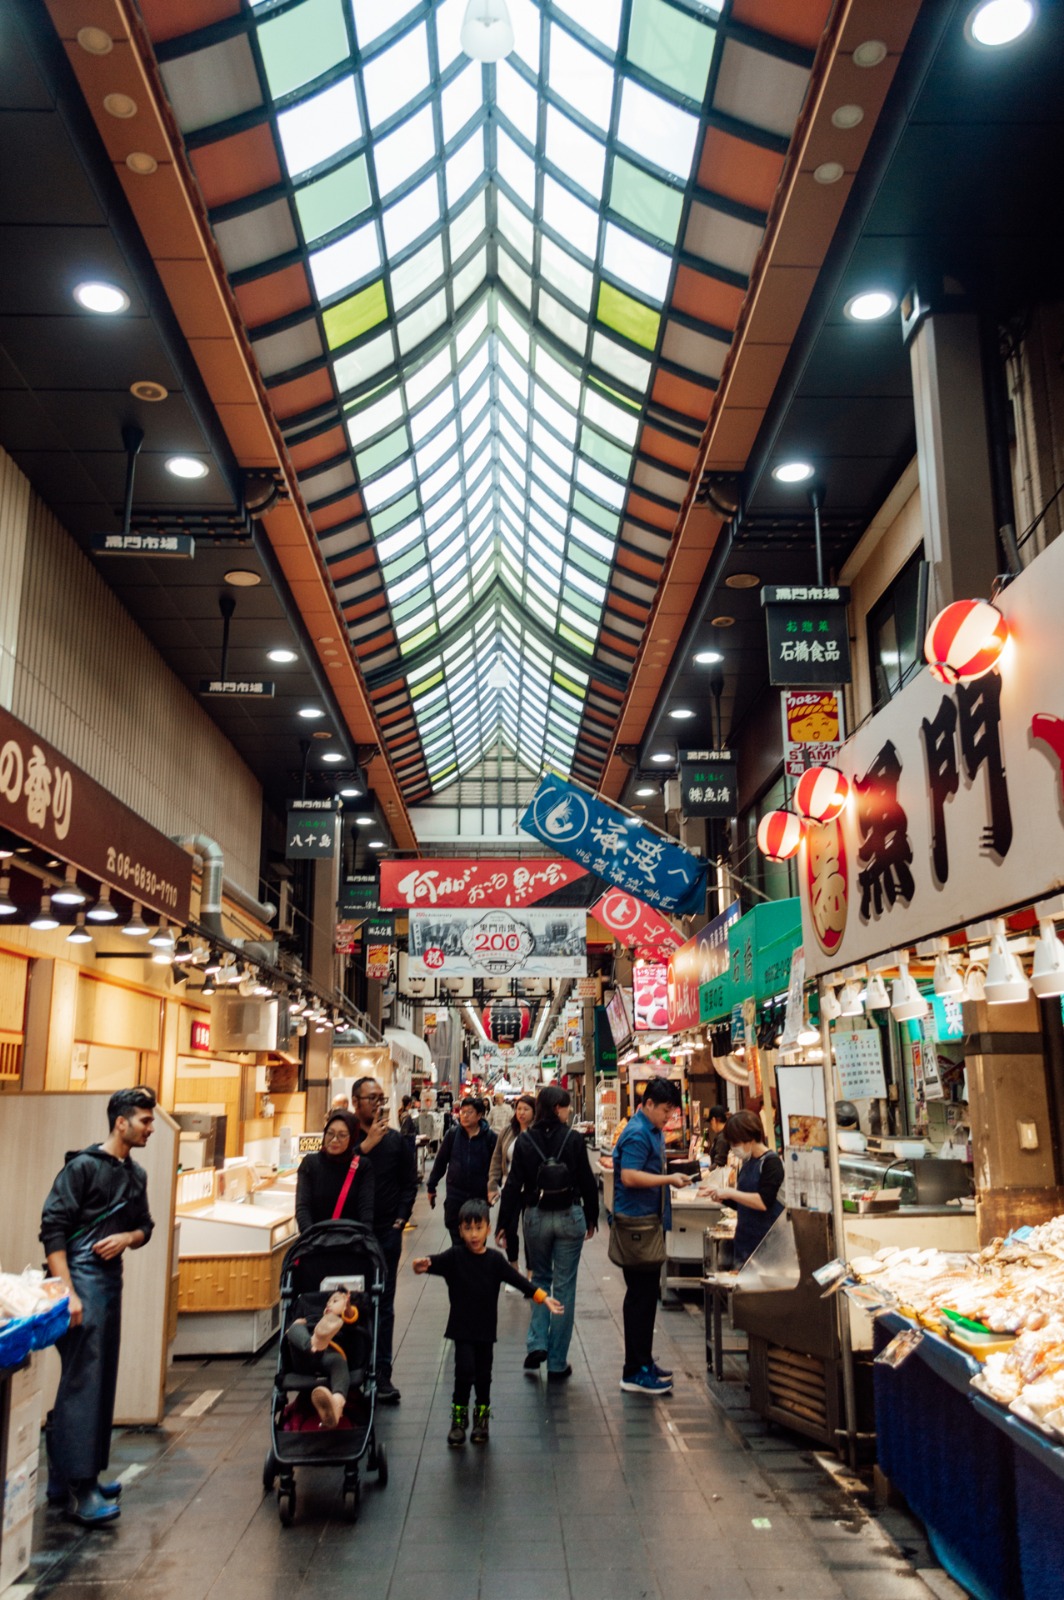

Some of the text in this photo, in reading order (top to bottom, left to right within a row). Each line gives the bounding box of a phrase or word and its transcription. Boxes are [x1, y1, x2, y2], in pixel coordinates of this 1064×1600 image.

[104, 535, 179, 550] 黒門市場
[775, 587, 840, 600] 黒門市場
[786, 620, 829, 632] お惣菜
[779, 640, 840, 662] 石橋食品
[208, 682, 263, 693] 黒門市場
[787, 694, 820, 707] クロモン
[686, 750, 731, 760] 黒門市場
[289, 833, 332, 848] 八十島
[479, 923, 517, 934] 黒門市場
[475, 933, 520, 951] 200
[426, 949, 443, 967] 祝
[732, 938, 753, 984] 石橋
